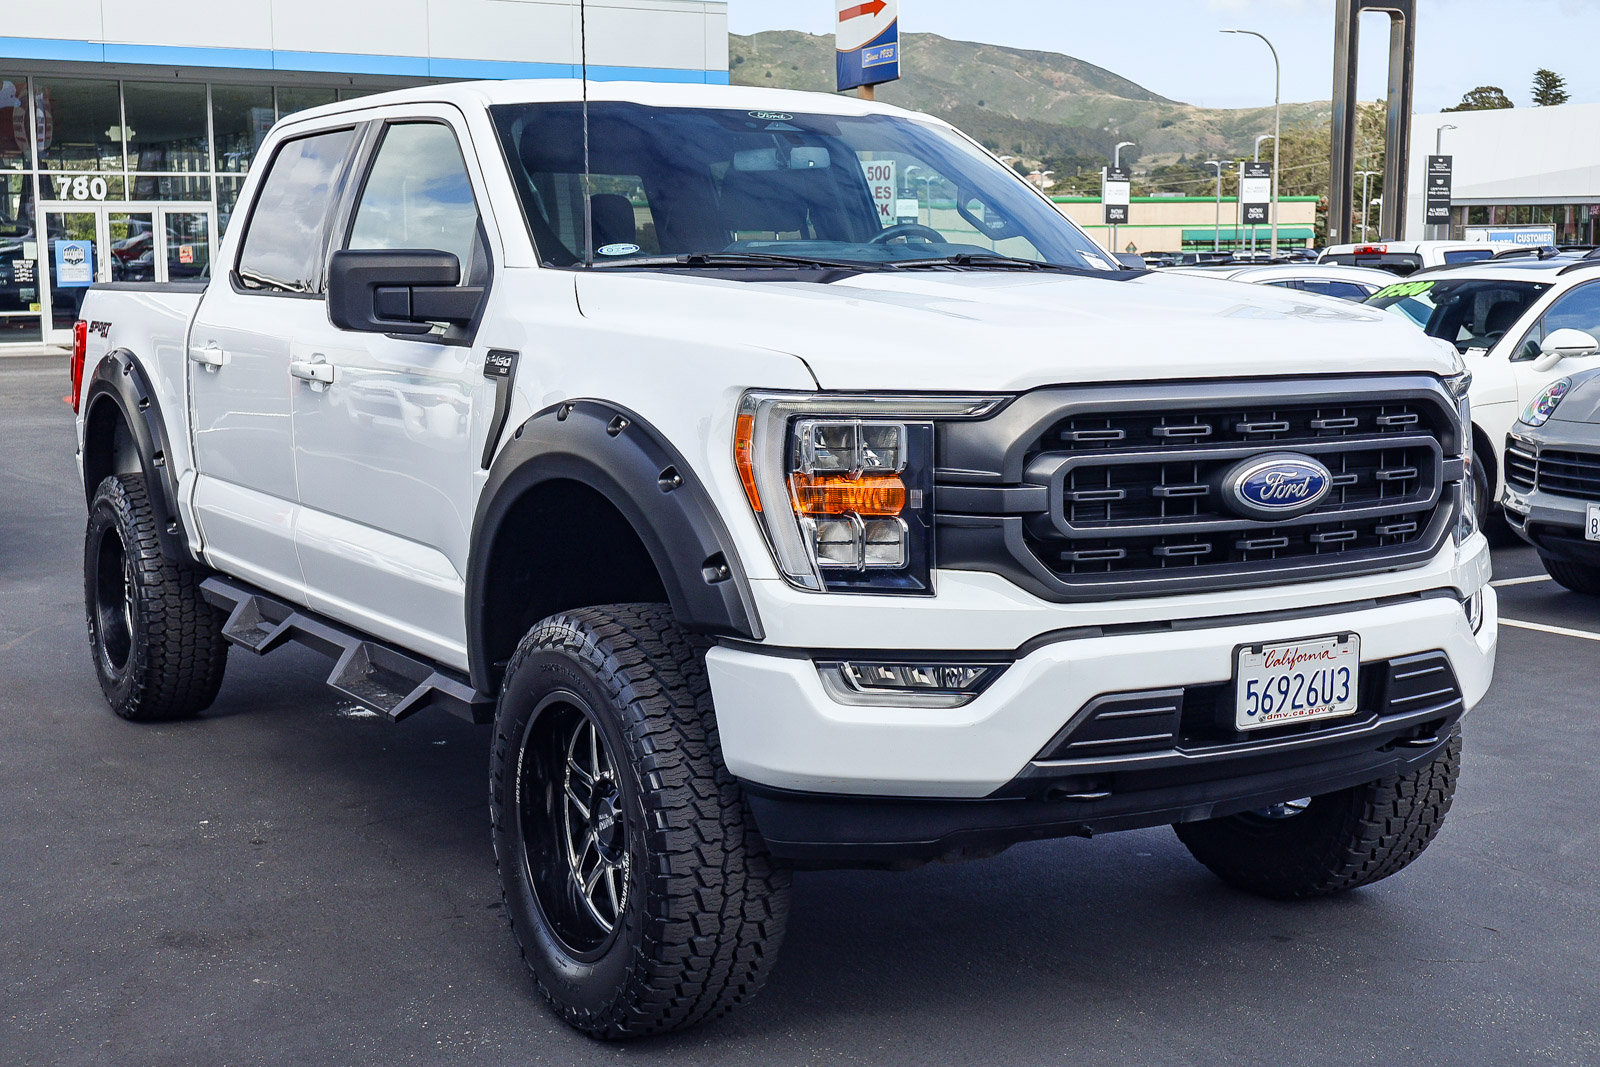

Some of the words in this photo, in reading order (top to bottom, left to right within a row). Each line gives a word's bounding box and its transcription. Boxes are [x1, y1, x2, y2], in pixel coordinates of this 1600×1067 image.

[57, 175, 107, 200] 780
[873, 186, 891, 199] ES
[1517, 233, 1552, 242] CUSTOMER
[1260, 471, 1310, 500] Ford
[1264, 646, 1337, 671] California
[1246, 666, 1350, 716] 56926U3
[1266, 706, 1327, 721] dmv.ca.gov
